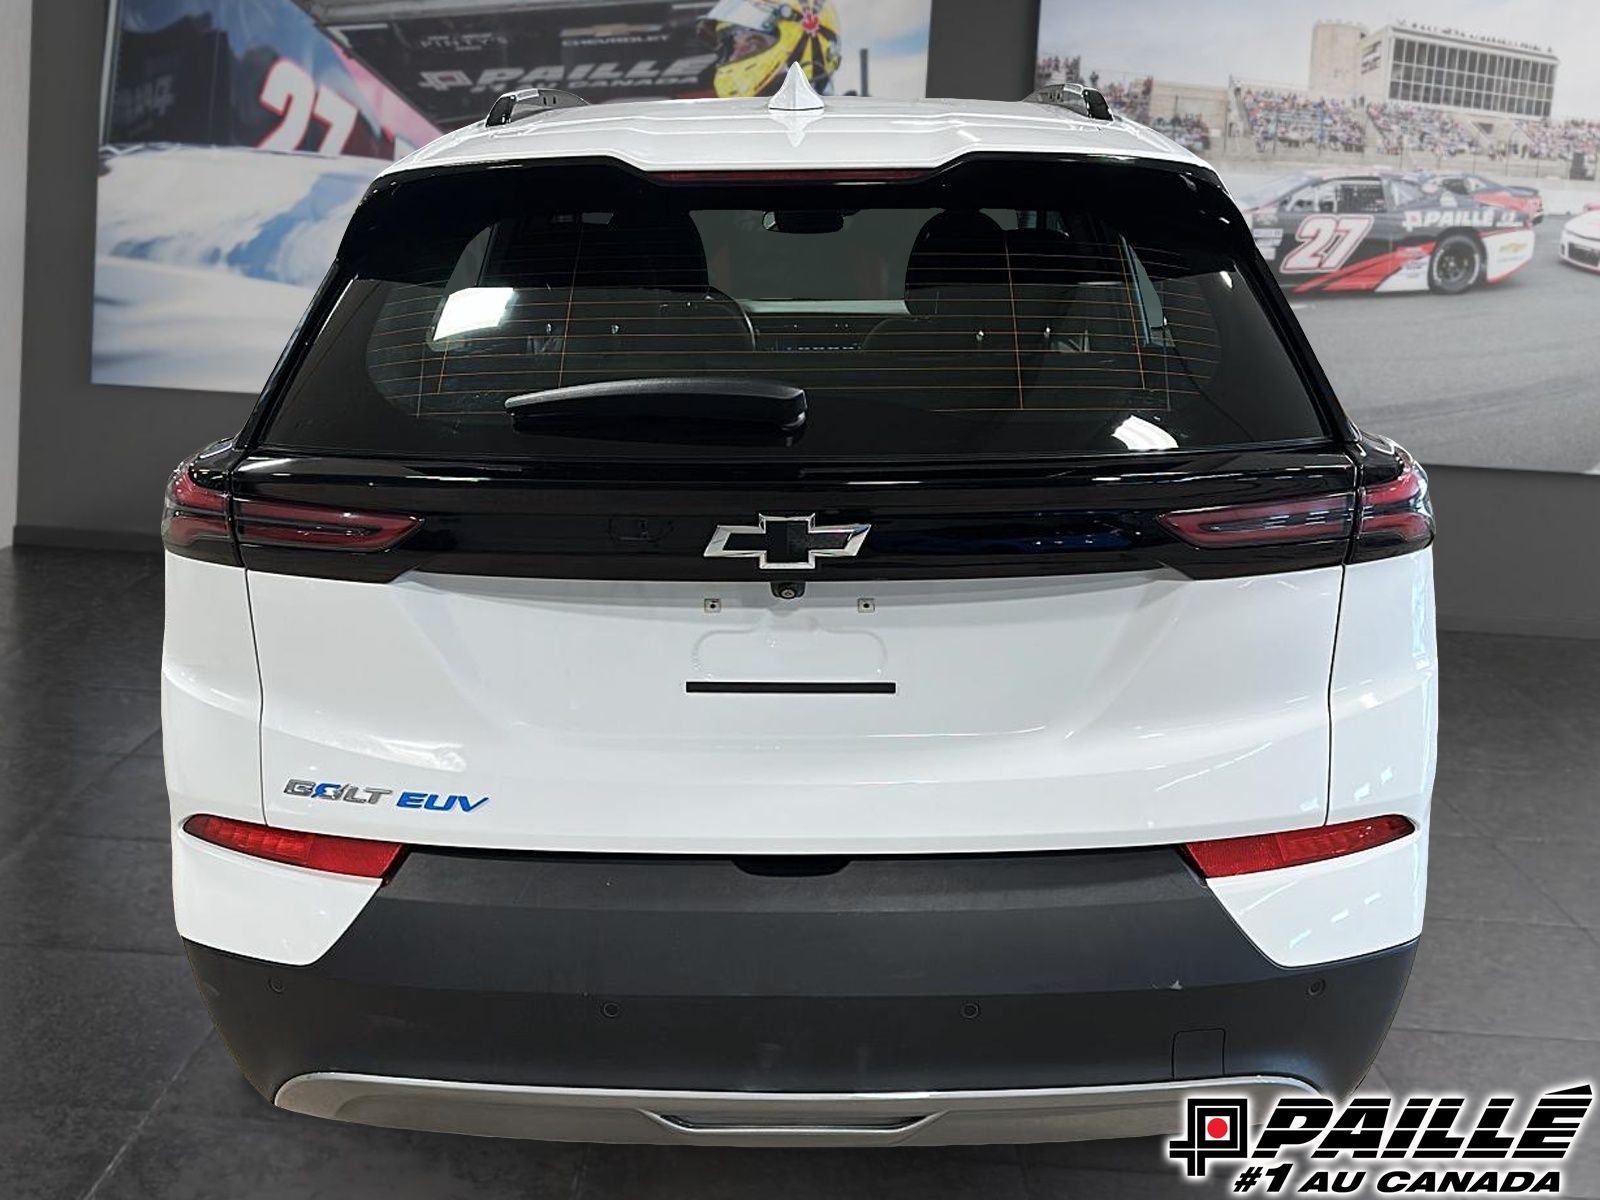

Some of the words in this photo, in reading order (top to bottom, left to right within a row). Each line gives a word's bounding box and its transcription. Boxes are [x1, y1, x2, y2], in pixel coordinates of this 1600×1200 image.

[256, 57, 360, 155] 27
[1280, 213, 1375, 273] 27
[283, 778, 393, 805] BOLT
[396, 791, 489, 813] EUV
